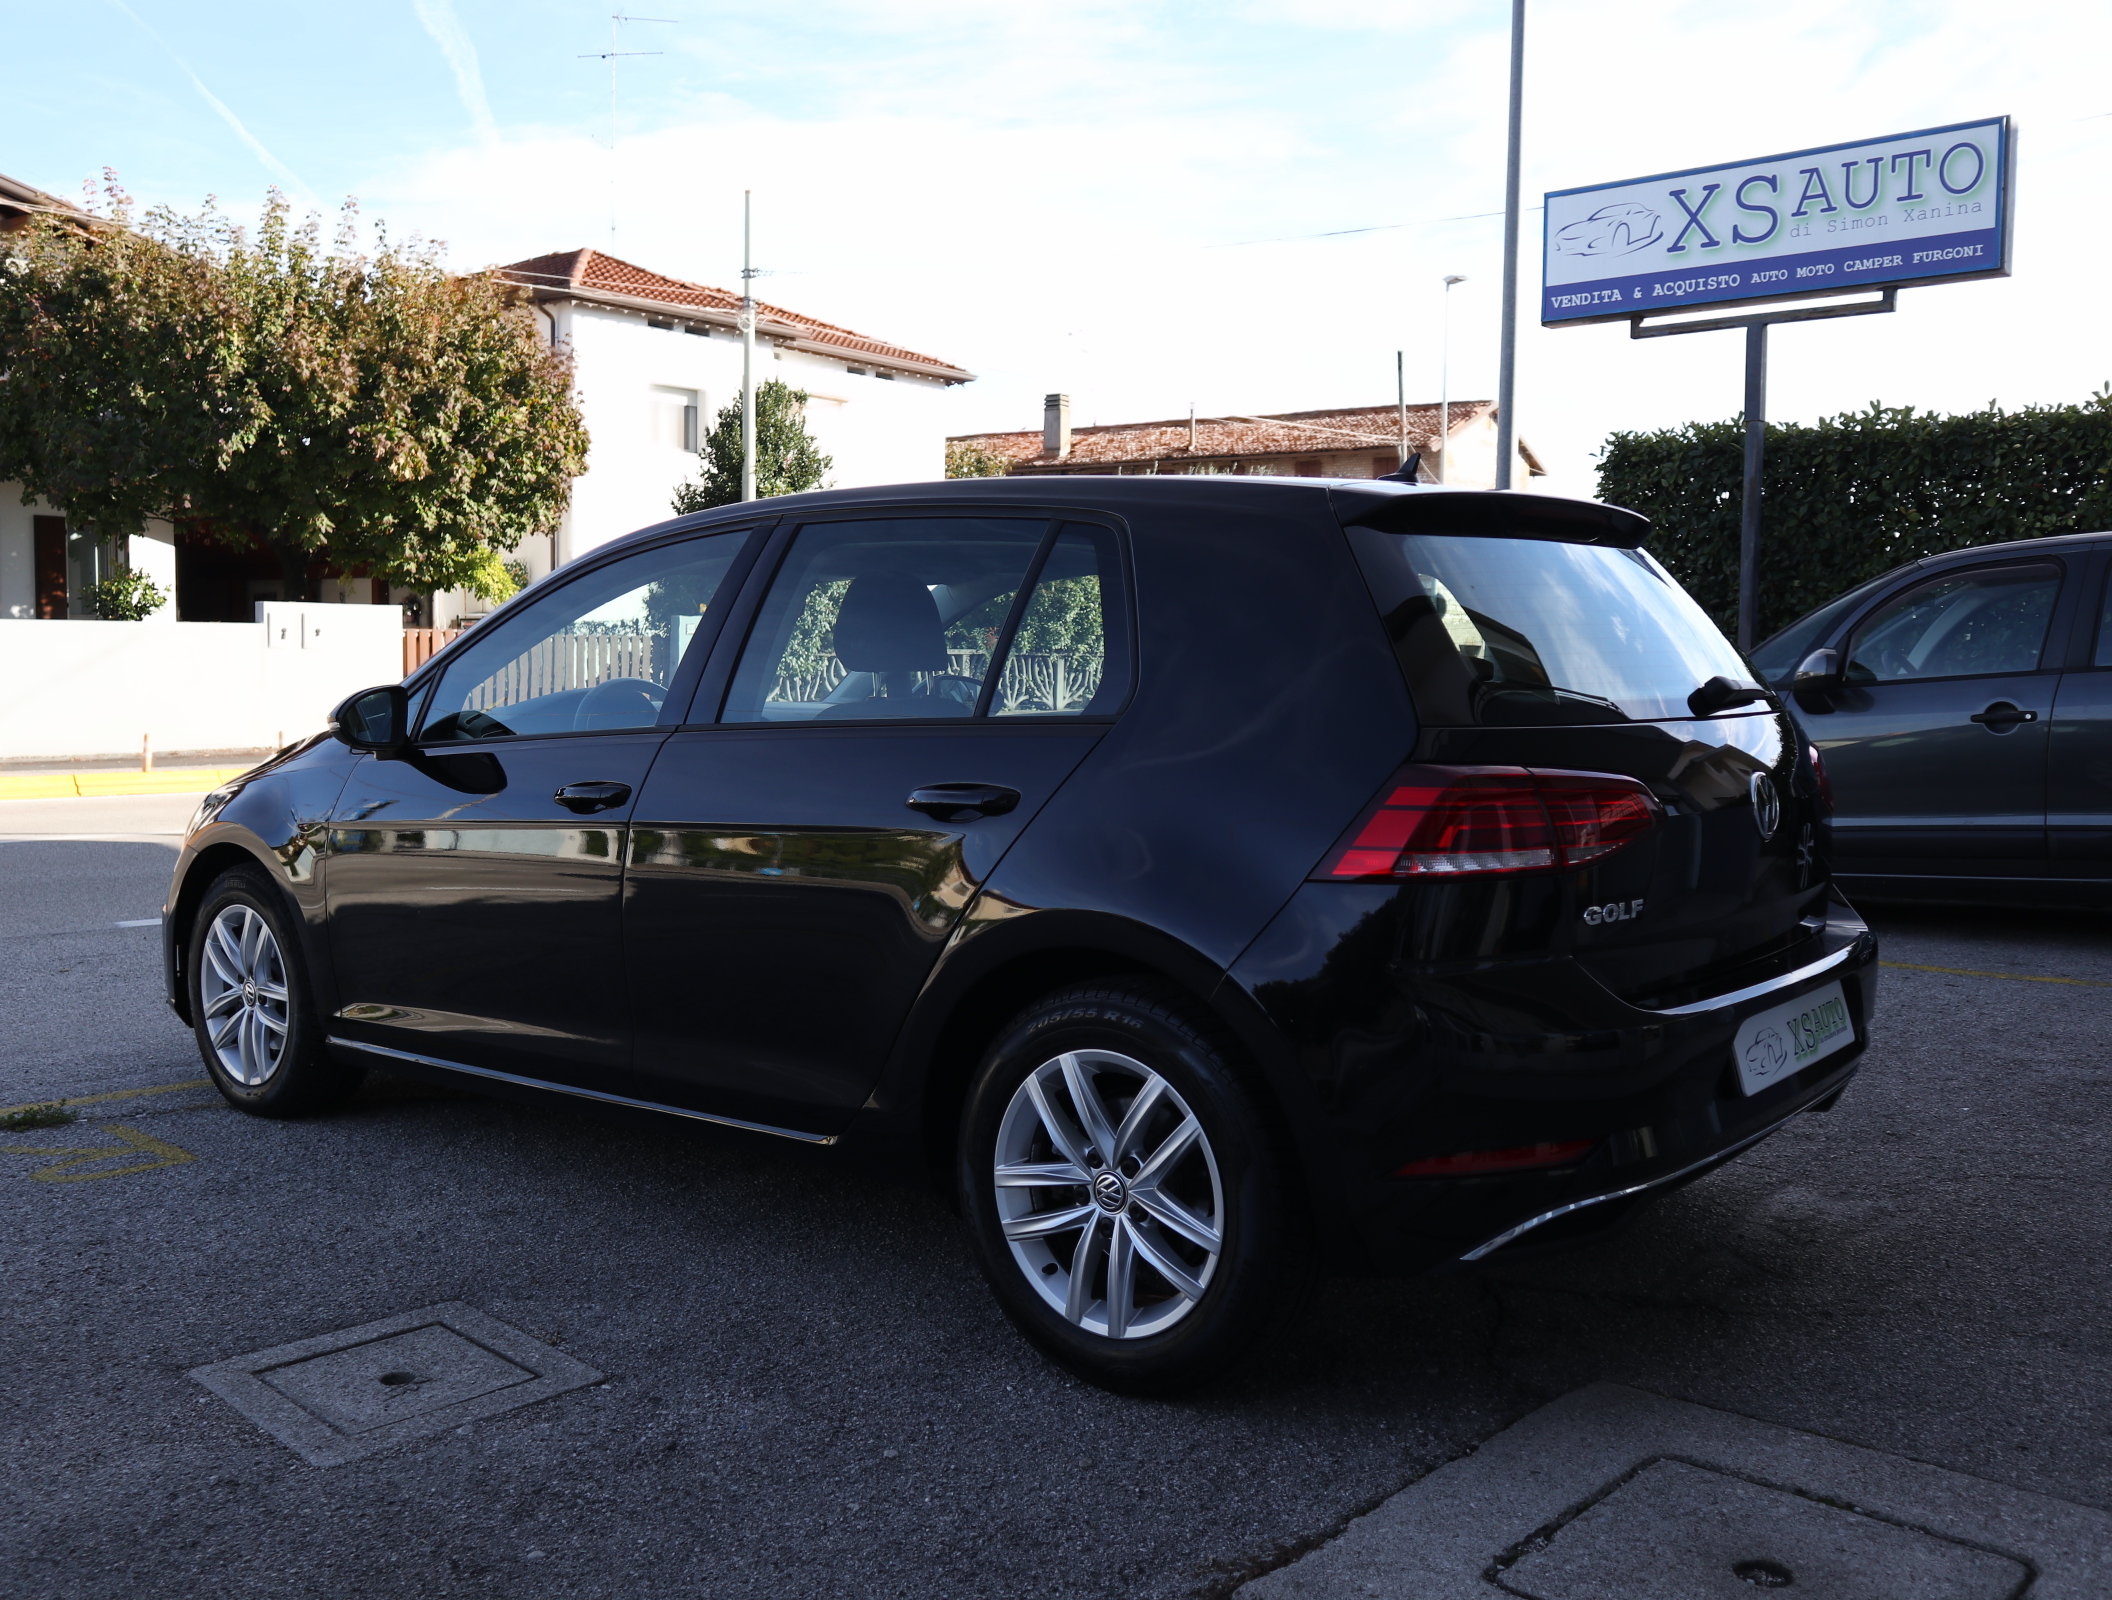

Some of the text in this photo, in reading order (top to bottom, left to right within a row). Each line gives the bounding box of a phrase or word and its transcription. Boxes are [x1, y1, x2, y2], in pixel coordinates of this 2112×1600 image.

[1790, 201, 1983, 238] di Simon Xanina
[1551, 244, 1984, 308] VENDITA & ACQUISTO AUTO MOTO CAMPER FURGONI
[1583, 899, 1644, 925] GOLF
[1026, 1008, 1145, 1035] 205/55 R16
